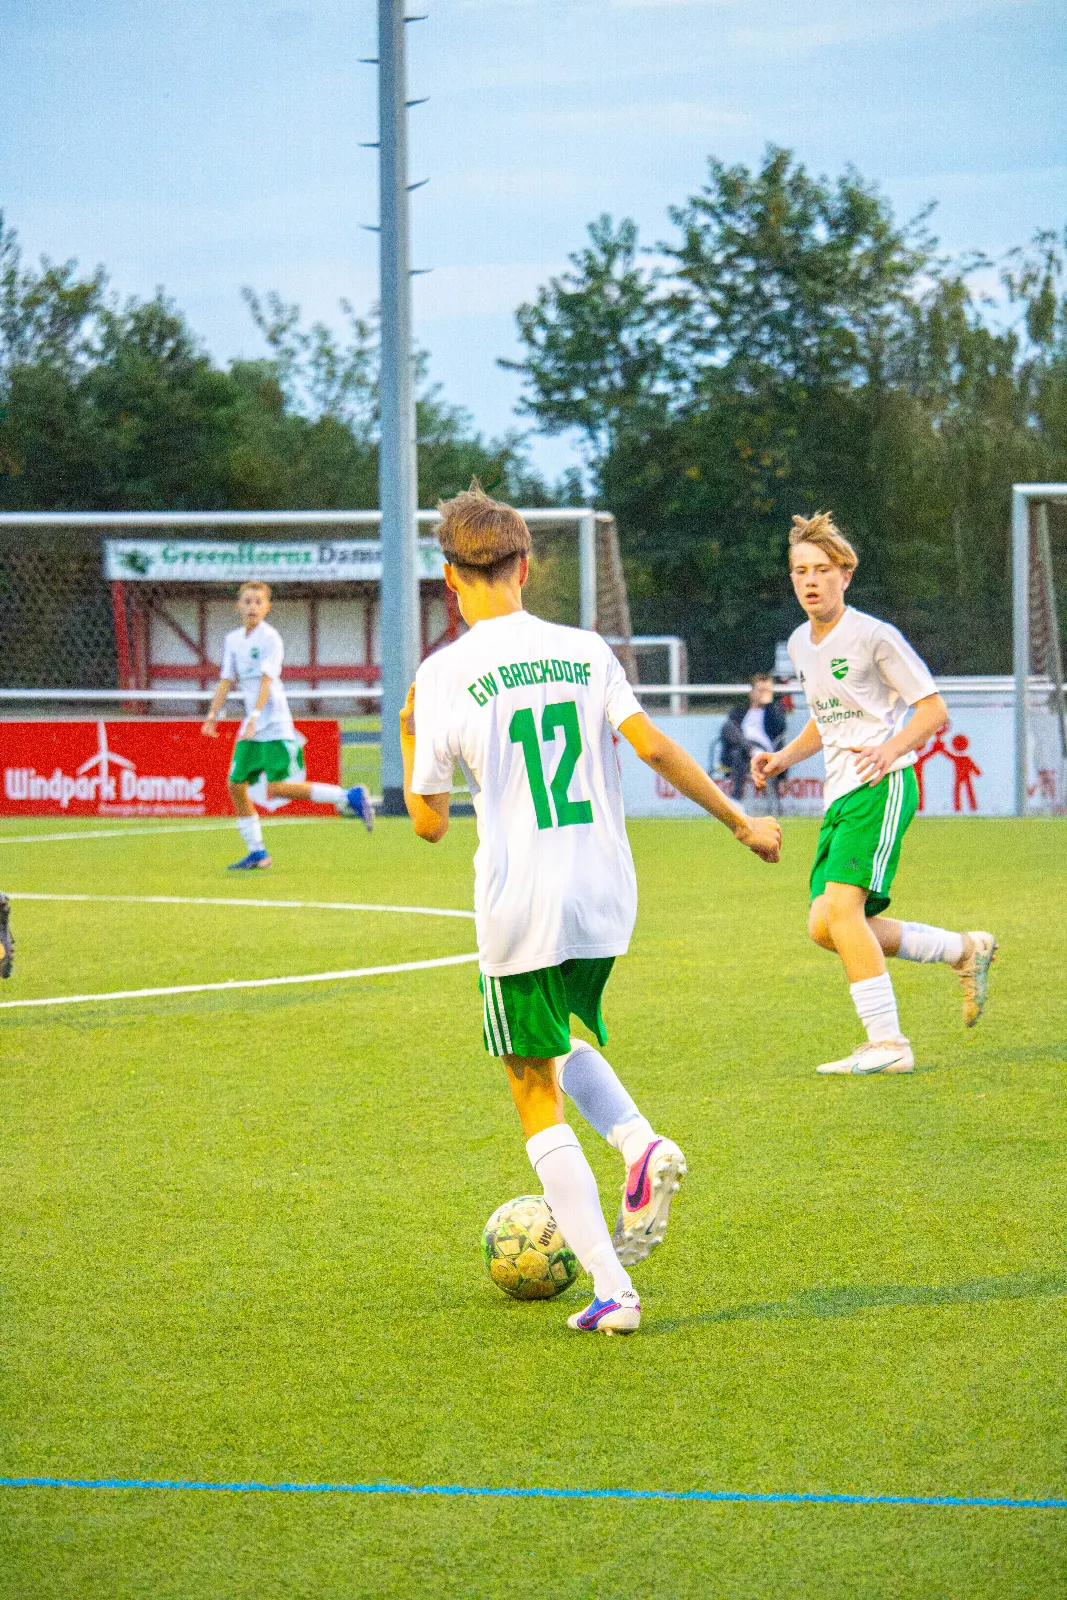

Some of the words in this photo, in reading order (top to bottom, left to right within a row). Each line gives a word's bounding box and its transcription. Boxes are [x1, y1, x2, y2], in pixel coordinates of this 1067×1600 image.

[467, 672, 499, 707] GW
[498, 659, 591, 689] BROCKDORF
[4, 768, 116, 808] Windpark
[120, 770, 205, 800] Damme
[509, 700, 594, 830] 12
